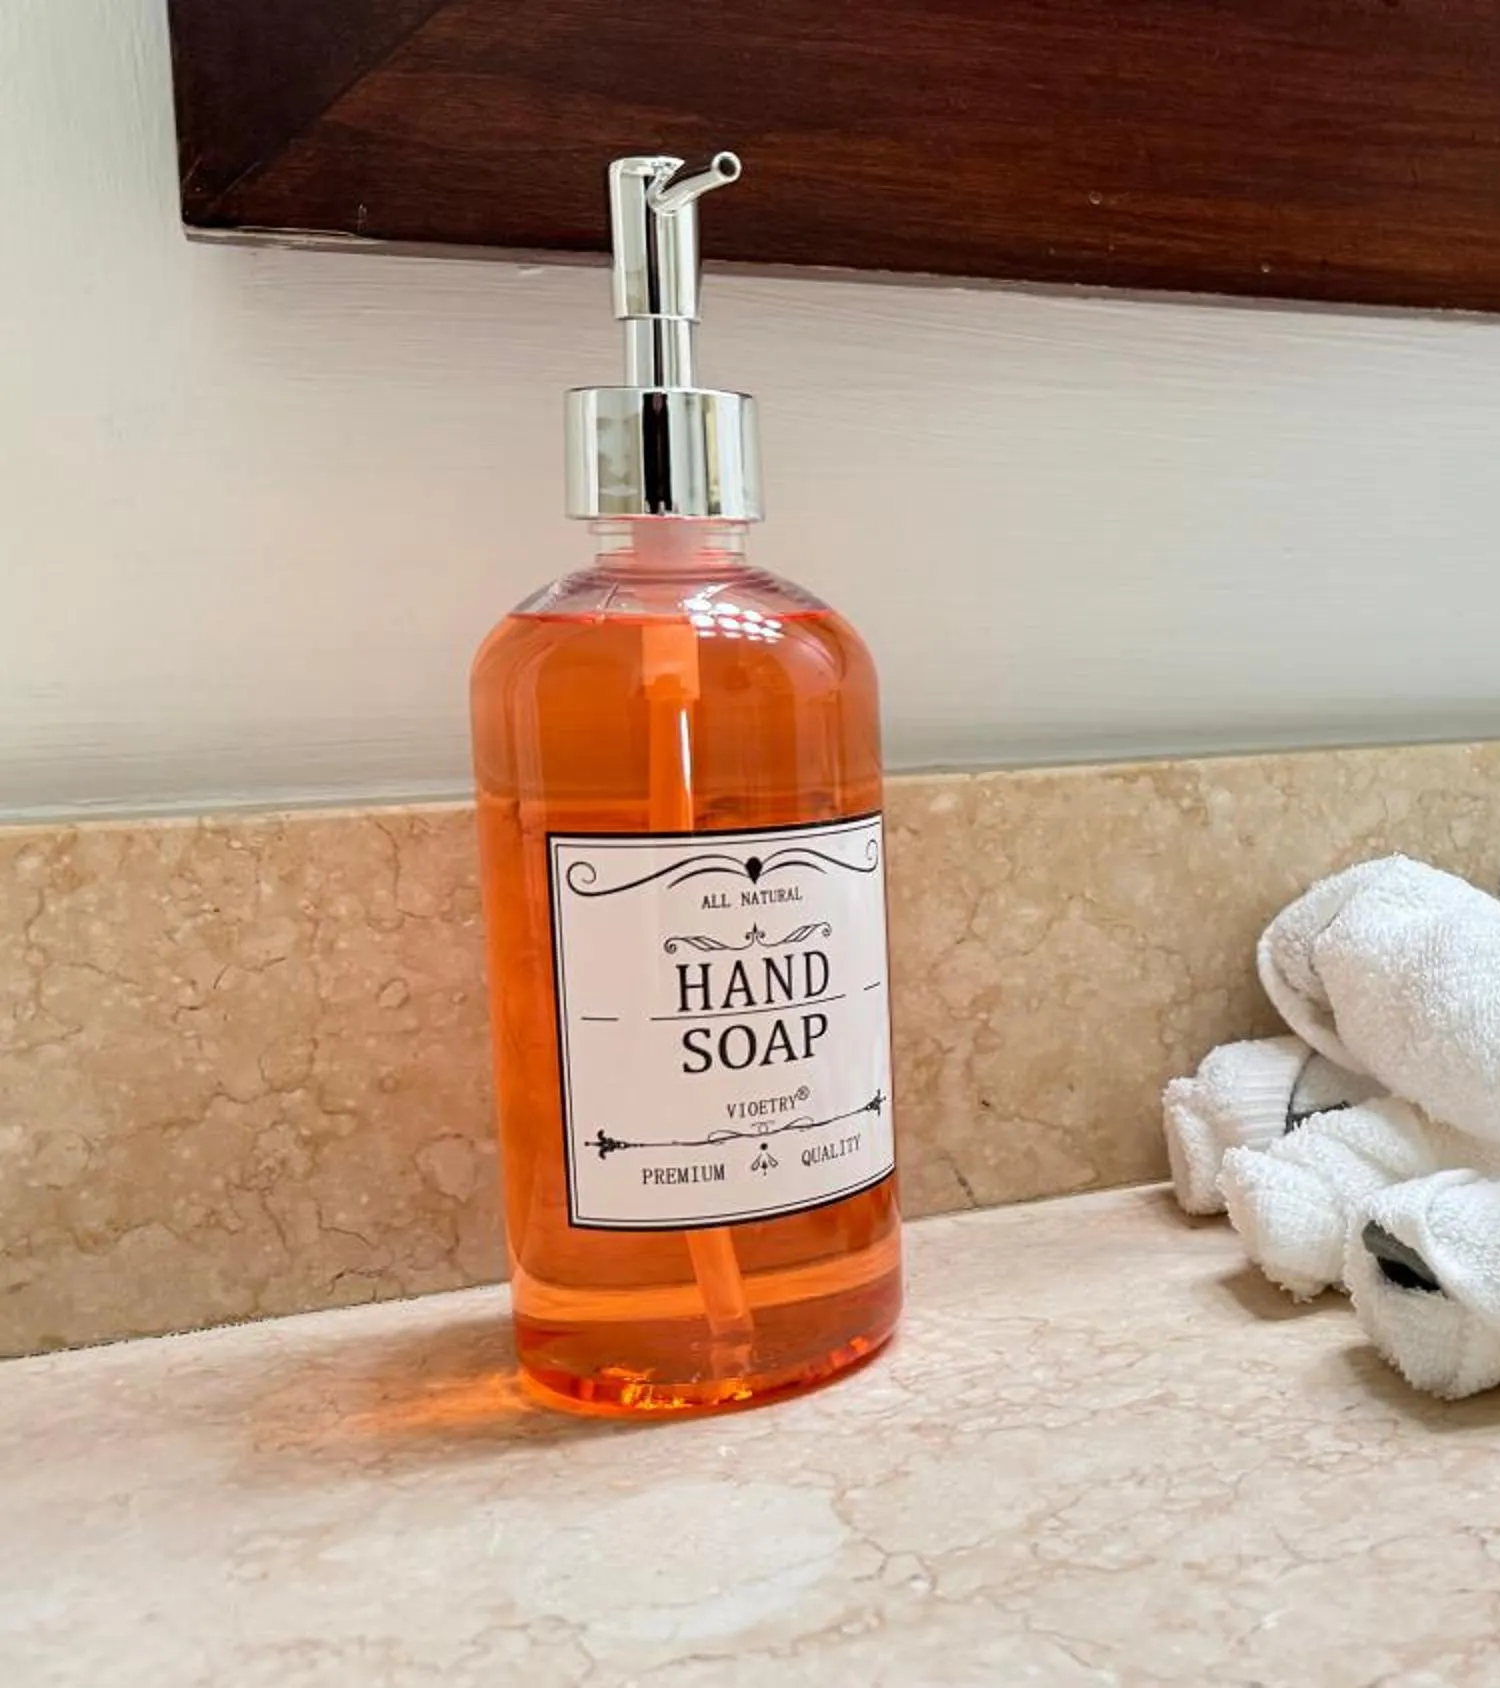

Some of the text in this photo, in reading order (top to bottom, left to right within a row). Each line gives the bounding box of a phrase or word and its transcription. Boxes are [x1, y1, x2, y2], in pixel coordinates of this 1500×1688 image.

[702, 887, 803, 909] ALL NATURAL
[675, 949, 831, 1013] HAND
[682, 1013, 829, 1074] SOAP
[642, 1133, 862, 1185] PREMIUM QUALITY
